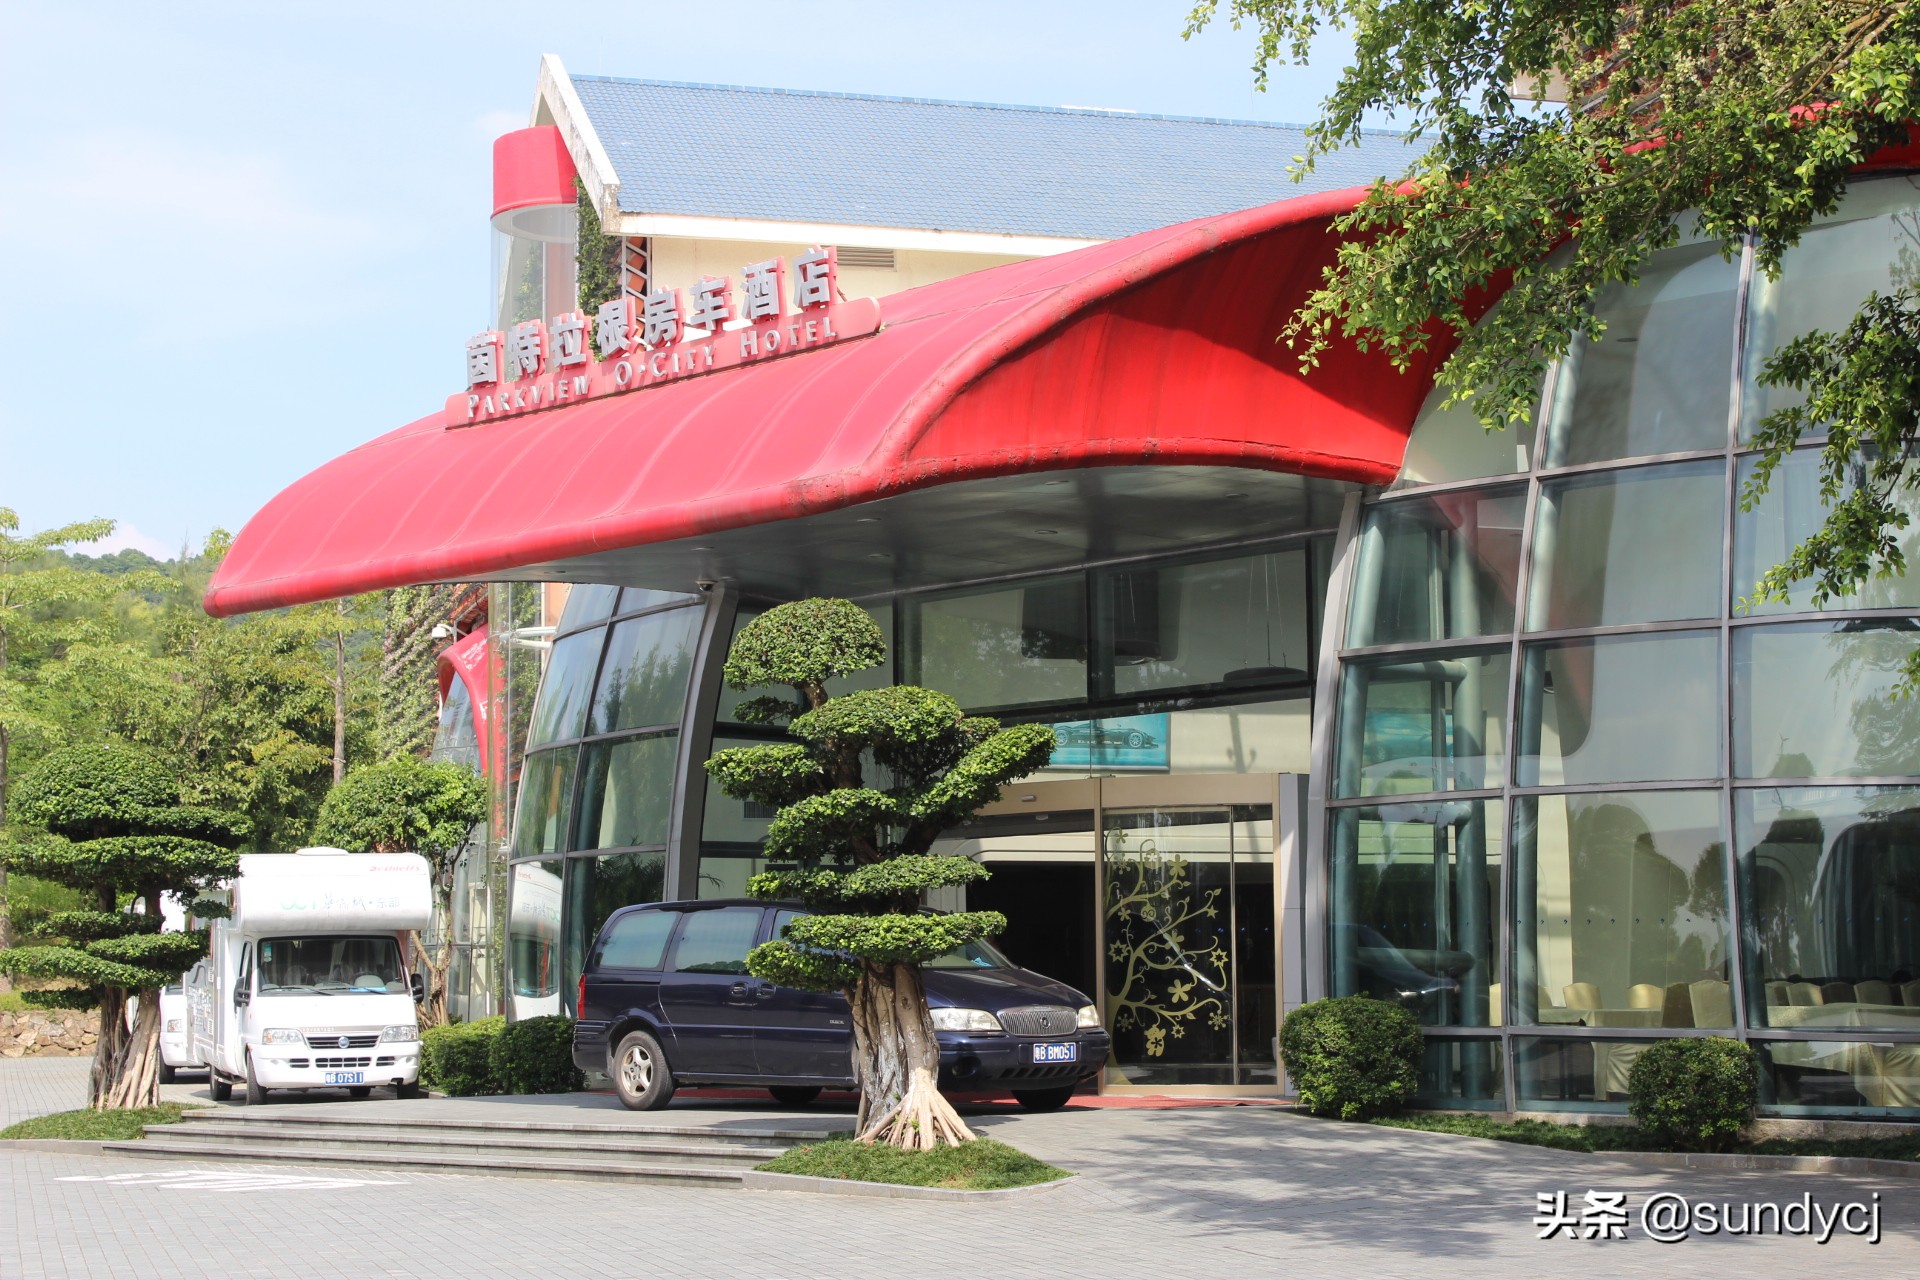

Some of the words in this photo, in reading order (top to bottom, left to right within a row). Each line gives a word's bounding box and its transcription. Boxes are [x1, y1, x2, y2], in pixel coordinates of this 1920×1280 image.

[465, 246, 833, 385] 茵特拉根房车酒店
[467, 375, 593, 418] PARKVIEW
[740, 316, 838, 358] HOTEL
